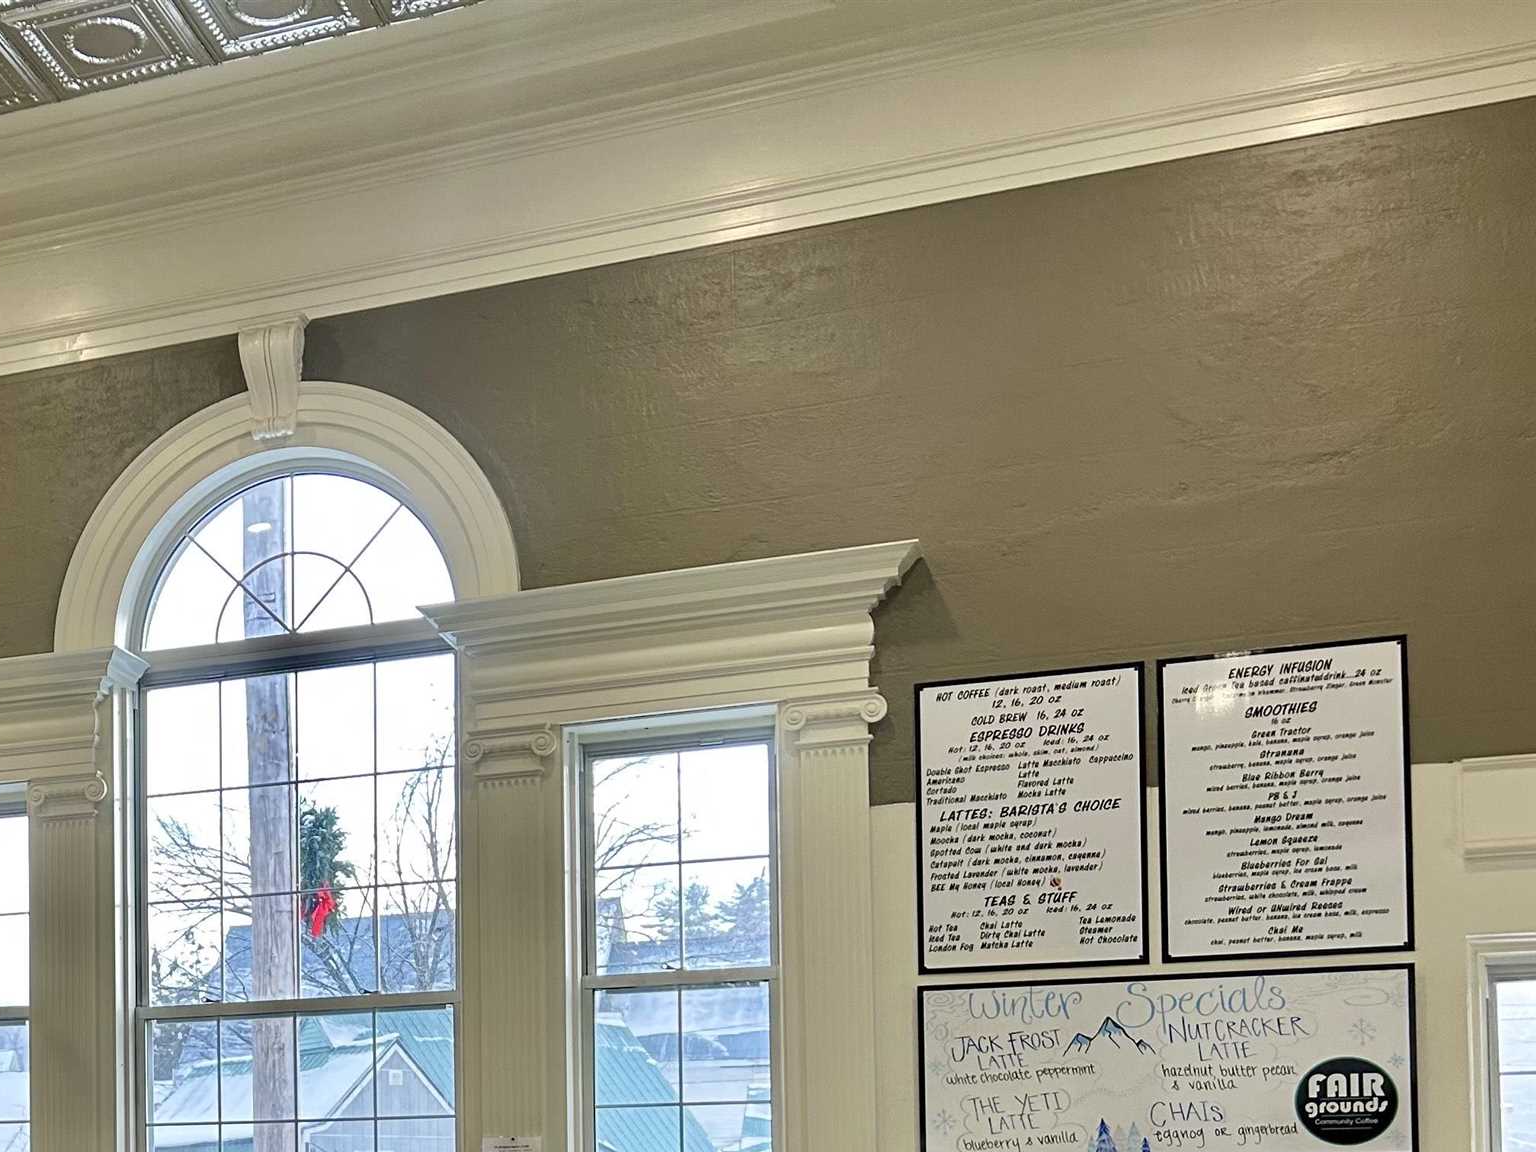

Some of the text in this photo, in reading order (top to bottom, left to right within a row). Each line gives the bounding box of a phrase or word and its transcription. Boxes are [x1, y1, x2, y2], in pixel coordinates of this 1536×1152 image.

[1229, 659, 1332, 679] ENERGY INFUSION
[936, 676, 1121, 701] HOT COFFEE (dark roast, medium roast)
[992, 700, 1006, 709] 12,
[1011, 698, 1024, 707] 16,
[1030, 696, 1043, 705] 20
[1244, 701, 1317, 719] SMOOTHIES
[971, 715, 994, 726] COLD
[999, 712, 1027, 723] BREW
[1037, 711, 1049, 721] 16,
[1054, 709, 1066, 718] 24
[970, 723, 1085, 743] ESPRESSO DRINKS
[1251, 727, 1312, 739] Green Tractor
[1018, 757, 1081, 770] Latte Macchiato
[1089, 753, 1134, 764] Cappuccino
[926, 767, 951, 777] Double
[976, 764, 1010, 773] Espresso
[1242, 769, 1324, 782] Blue Ribbon Berry
[1268, 792, 1280, 800] PB
[1292, 791, 1298, 799] J
[940, 798, 1122, 822] LATTES: BARISTA'S CHOICE
[1254, 813, 1314, 824] Mango Dream
[930, 825, 953, 834] Maple
[956, 822, 979, 832] (local
[983, 820, 1006, 829] maple
[1250, 835, 1318, 846] Lemon Squeeze
[1240, 860, 1292, 870] Blueberries
[1295, 858, 1309, 867] For
[1218, 882, 1276, 893] Strawberries
[1290, 879, 1318, 889] Cream
[1321, 877, 1353, 887] Frappe
[984, 891, 1078, 908] TEAS & STUFF
[1228, 906, 1253, 915] Wired
[1257, 906, 1267, 914] or
[1311, 901, 1343, 911] Reeses
[980, 920, 1023, 930] Chai Latte
[1079, 914, 1137, 925] Tea Lemonade
[929, 924, 958, 933] Hot Tea
[980, 928, 1045, 941] Dirty Chai Latte
[1268, 925, 1304, 935] Chai Me
[929, 933, 960, 943] Iced Tea
[981, 939, 1033, 950] Matcha Latte
[1079, 934, 1138, 944] Hot Chocolate
[929, 943, 974, 952] London Fog
[968, 975, 1286, 1036] Winter Specials
[1167, 1015, 1311, 1044] NUTCRACKER
[951, 1029, 1064, 1062] JACK FROST
[1198, 1040, 1257, 1062] LATTE
[977, 1053, 1029, 1071] LATTE
[946, 1063, 1096, 1086] white chocolate peppermint
[1161, 1063, 1296, 1081] hazelnut butter pecan
[1188, 1078, 1238, 1091] vanilla
[1307, 1072, 1385, 1099] FAIR
[967, 1091, 1063, 1121] THE YETI
[1304, 1096, 1389, 1118] grounds
[1149, 1100, 1225, 1128] CHAIS
[988, 1113, 1039, 1135] LATTE
[1038, 1130, 1079, 1145] vanilla
[1153, 1127, 1205, 1148] eggnog
[1237, 1123, 1299, 1146] gingerbread
